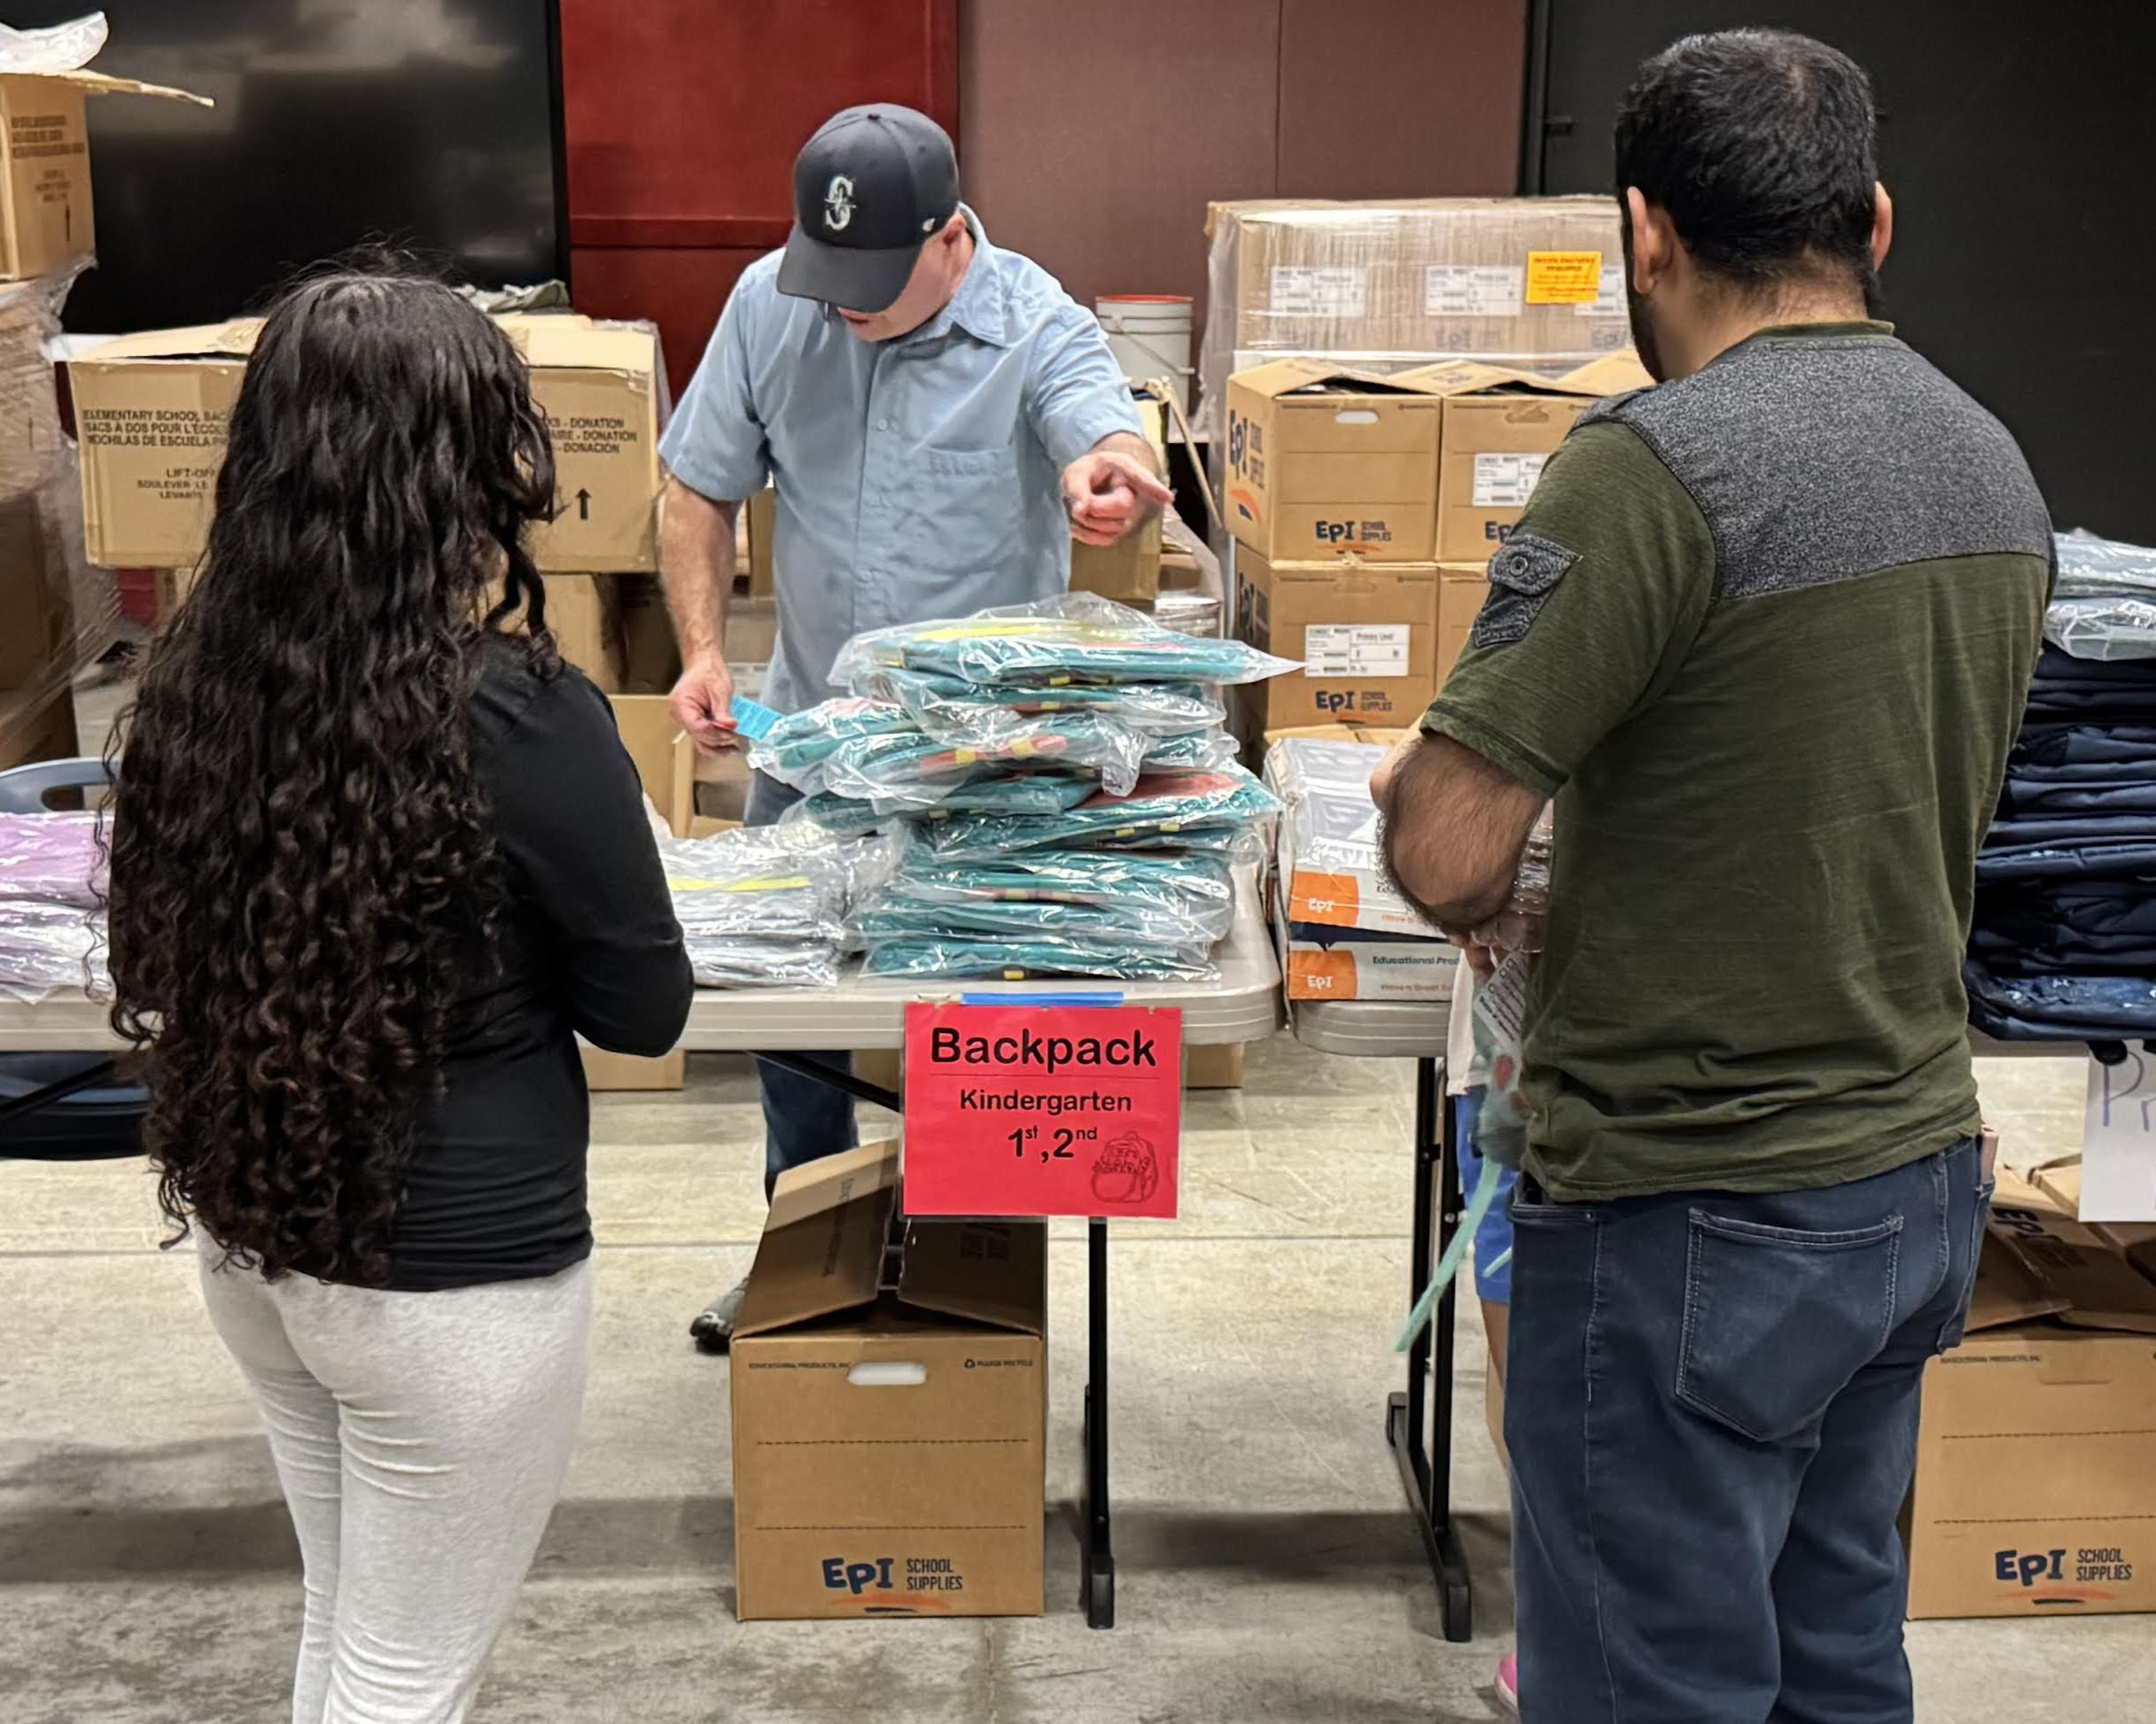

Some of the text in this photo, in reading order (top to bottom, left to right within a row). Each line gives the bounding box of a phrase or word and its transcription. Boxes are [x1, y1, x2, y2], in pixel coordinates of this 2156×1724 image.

[83, 409, 153, 421] ELEMENTARY
[157, 410, 200, 423] SCHOOL
[570, 417, 625, 429] DONATION
[125, 423, 148, 433] DOS
[151, 423, 182, 434] POUR
[142, 436, 157, 447] DE
[160, 436, 210, 447] ESCUELA
[582, 431, 637, 442] DONATION
[1484, 521, 1512, 544] Ep
[1373, 956, 1435, 965] Educational
[930, 1027, 1156, 1075] Backpack
[960, 1089, 1132, 1116] Kindergarten
[2076, 1548, 2124, 1564] SCHOOL
[906, 1558, 954, 1573] SCHOOL
[2076, 1565, 2132, 1581] SUPPLIES
[906, 1575, 964, 1590] SUPPLIES
